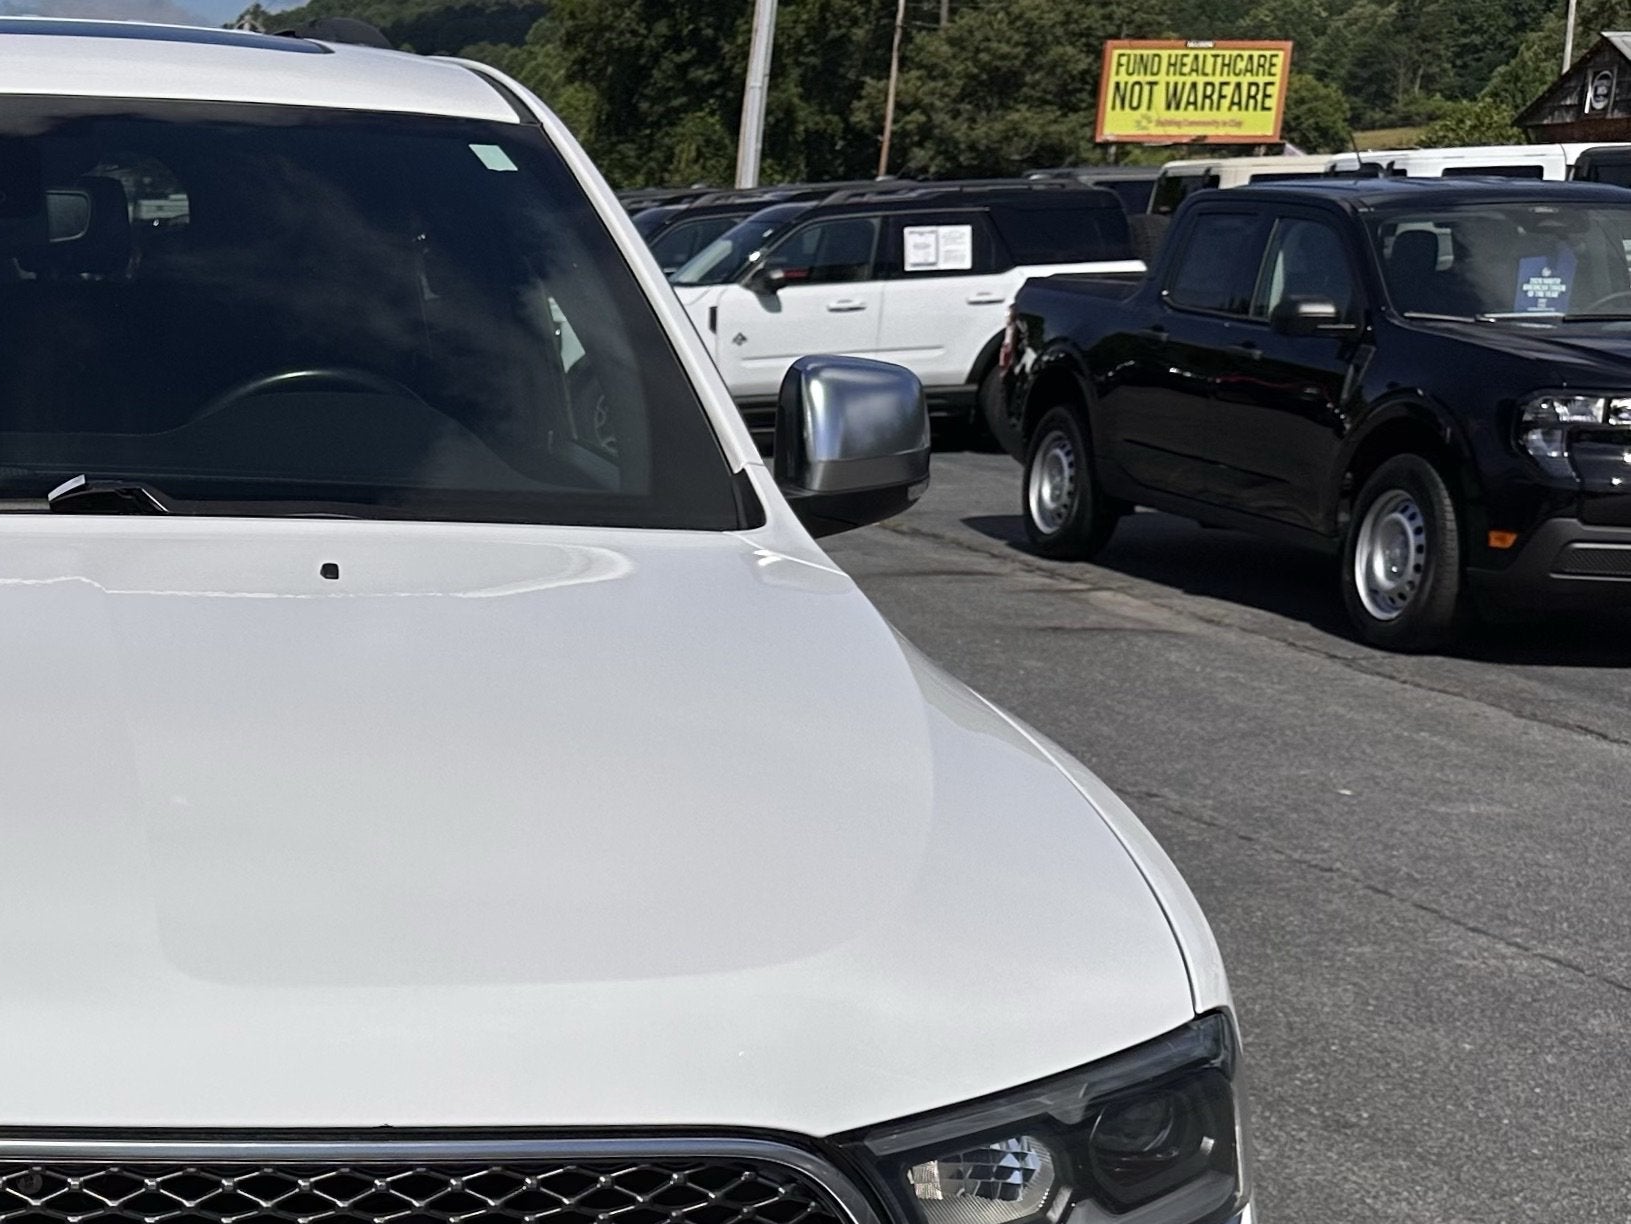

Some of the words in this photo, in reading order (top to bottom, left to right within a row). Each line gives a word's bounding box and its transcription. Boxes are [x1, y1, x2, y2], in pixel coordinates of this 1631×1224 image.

[1115, 53, 1162, 76] FUND
[1166, 53, 1279, 77] HEALTHCARE
[1111, 81, 1159, 111] NOT
[1165, 81, 1275, 111] WARFARE
